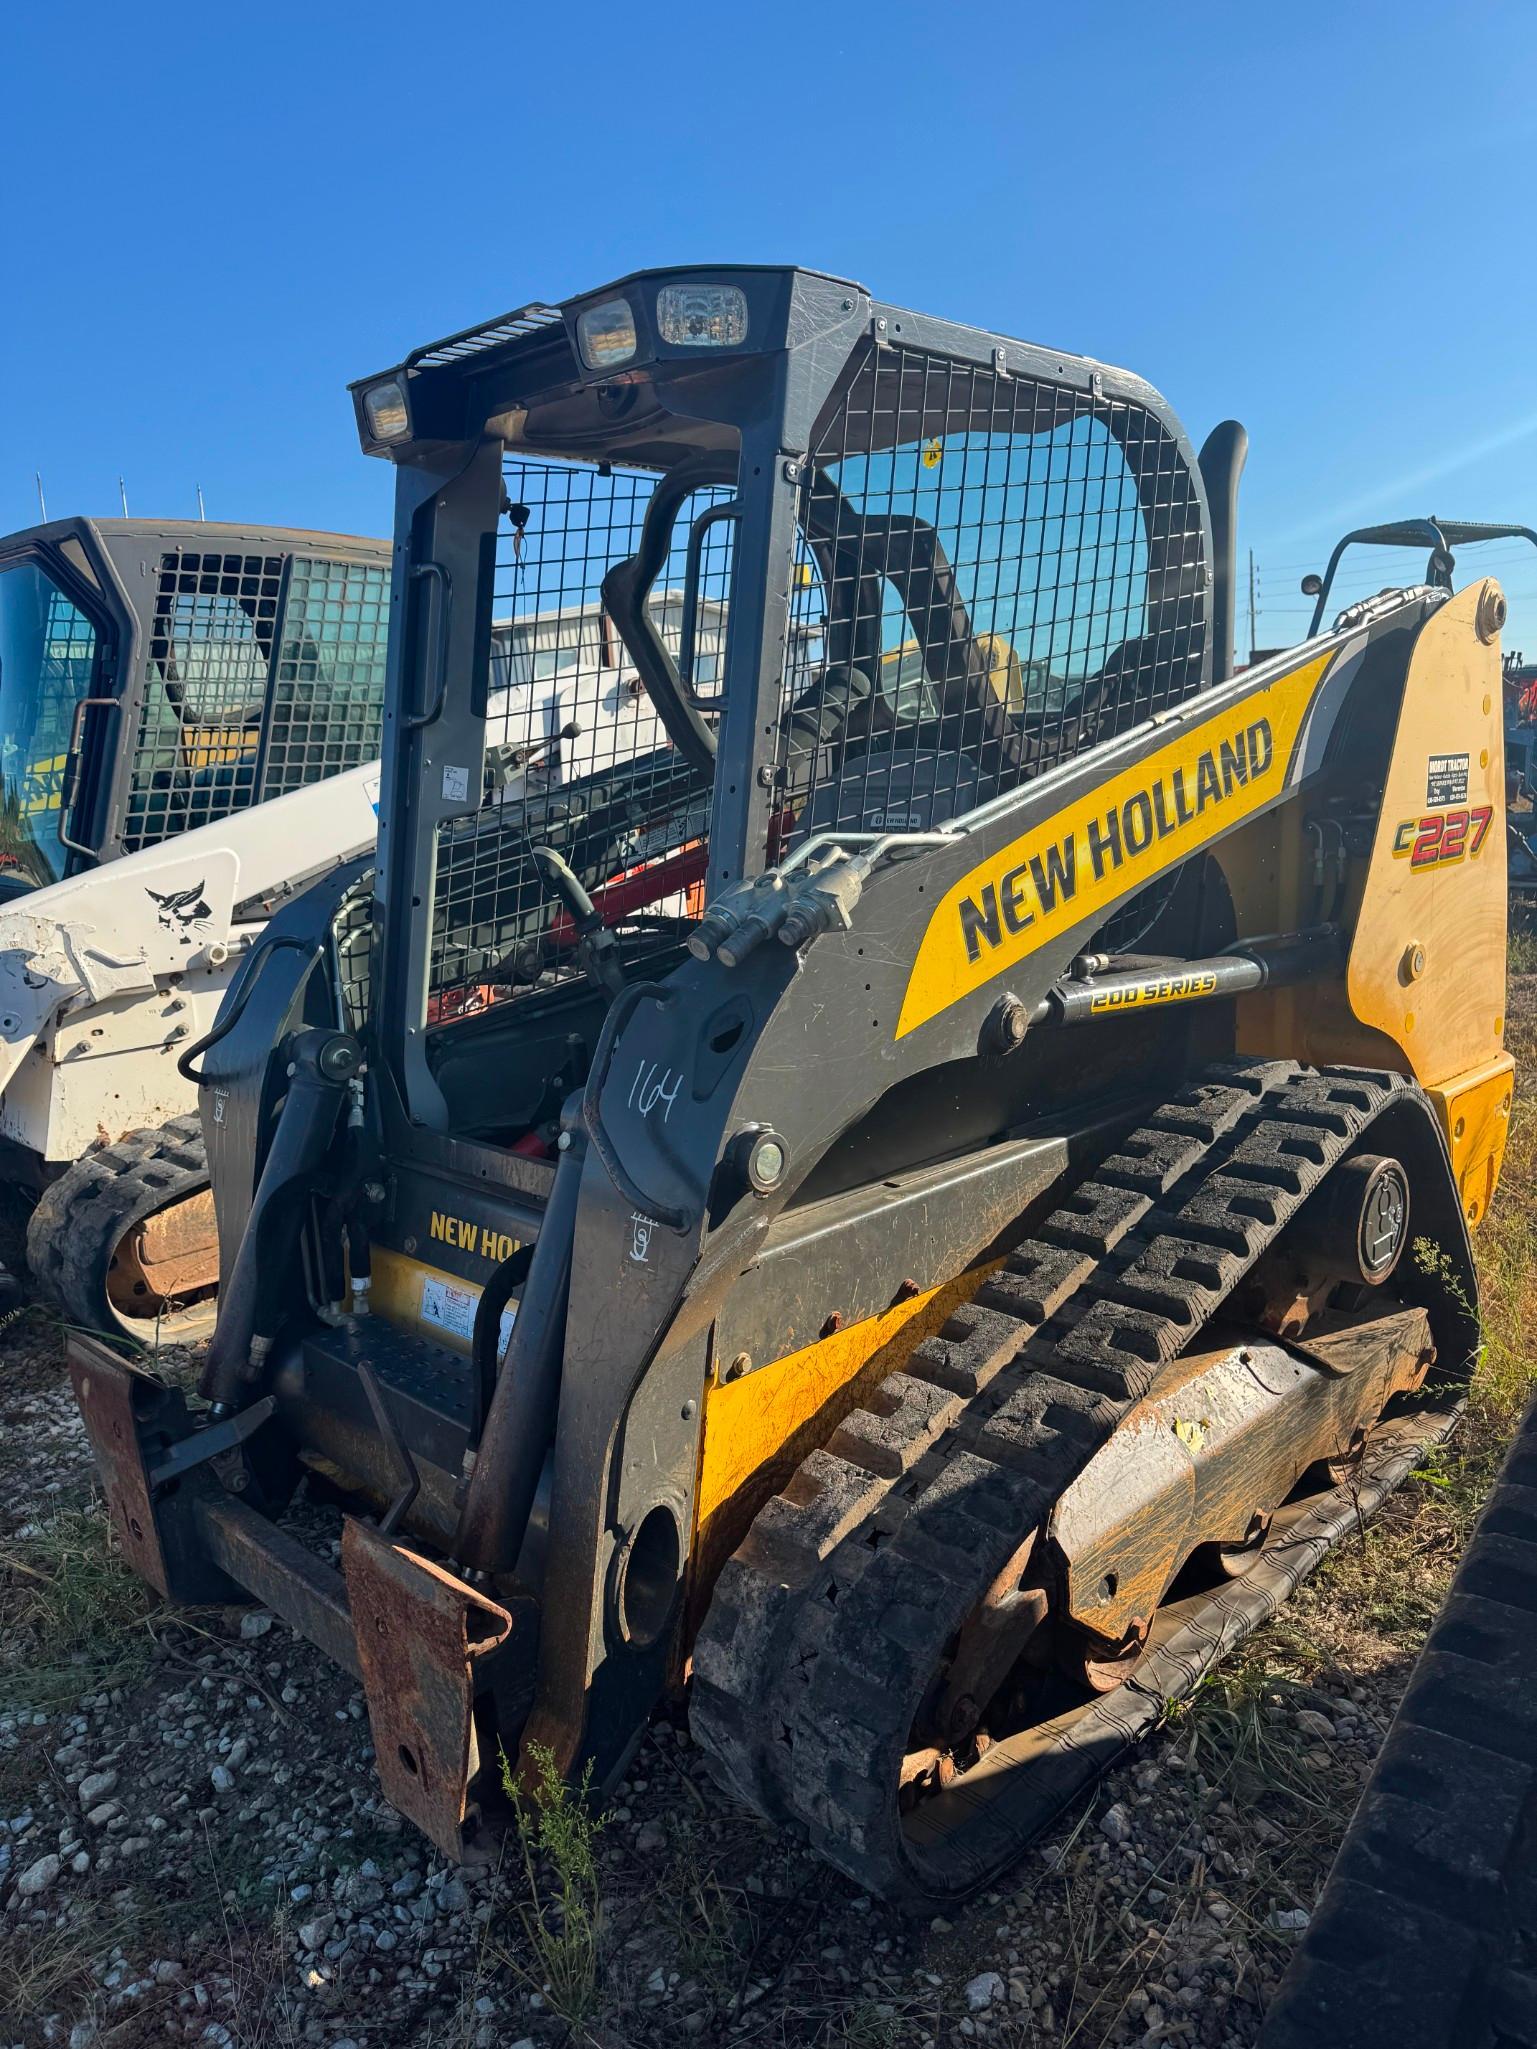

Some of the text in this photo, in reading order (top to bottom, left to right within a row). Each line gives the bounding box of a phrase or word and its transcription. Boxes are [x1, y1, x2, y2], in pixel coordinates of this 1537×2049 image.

[959, 717, 1273, 964] NEW HOLLAND
[1392, 806, 1494, 872] C227
[1093, 974, 1215, 1008] 200 SERIES
[628, 1060, 684, 1123] 164
[430, 1211, 478, 1252] NEW
